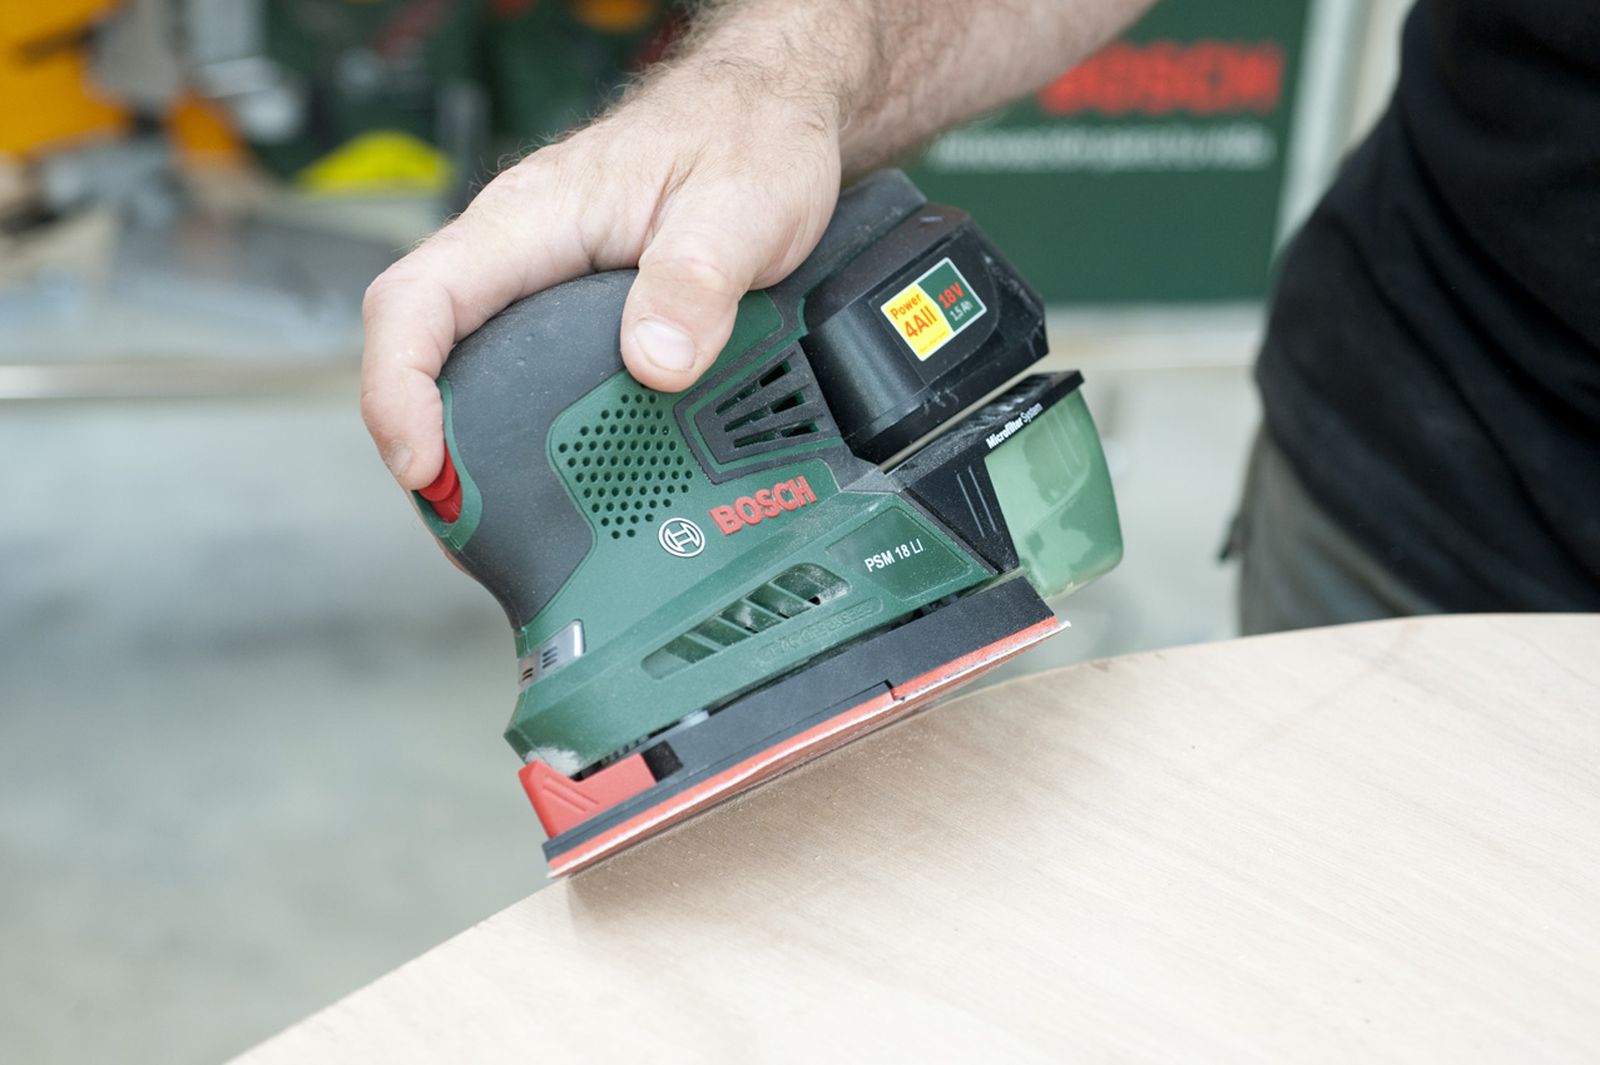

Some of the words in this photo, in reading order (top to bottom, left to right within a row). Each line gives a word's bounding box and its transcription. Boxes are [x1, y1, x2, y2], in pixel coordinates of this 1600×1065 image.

[889, 293, 923, 321] Power
[937, 281, 965, 310] 18V
[903, 304, 938, 338] 4All
[708, 474, 818, 537] BOSCH
[863, 549, 896, 573] PSM
[894, 543, 911, 560] 18
